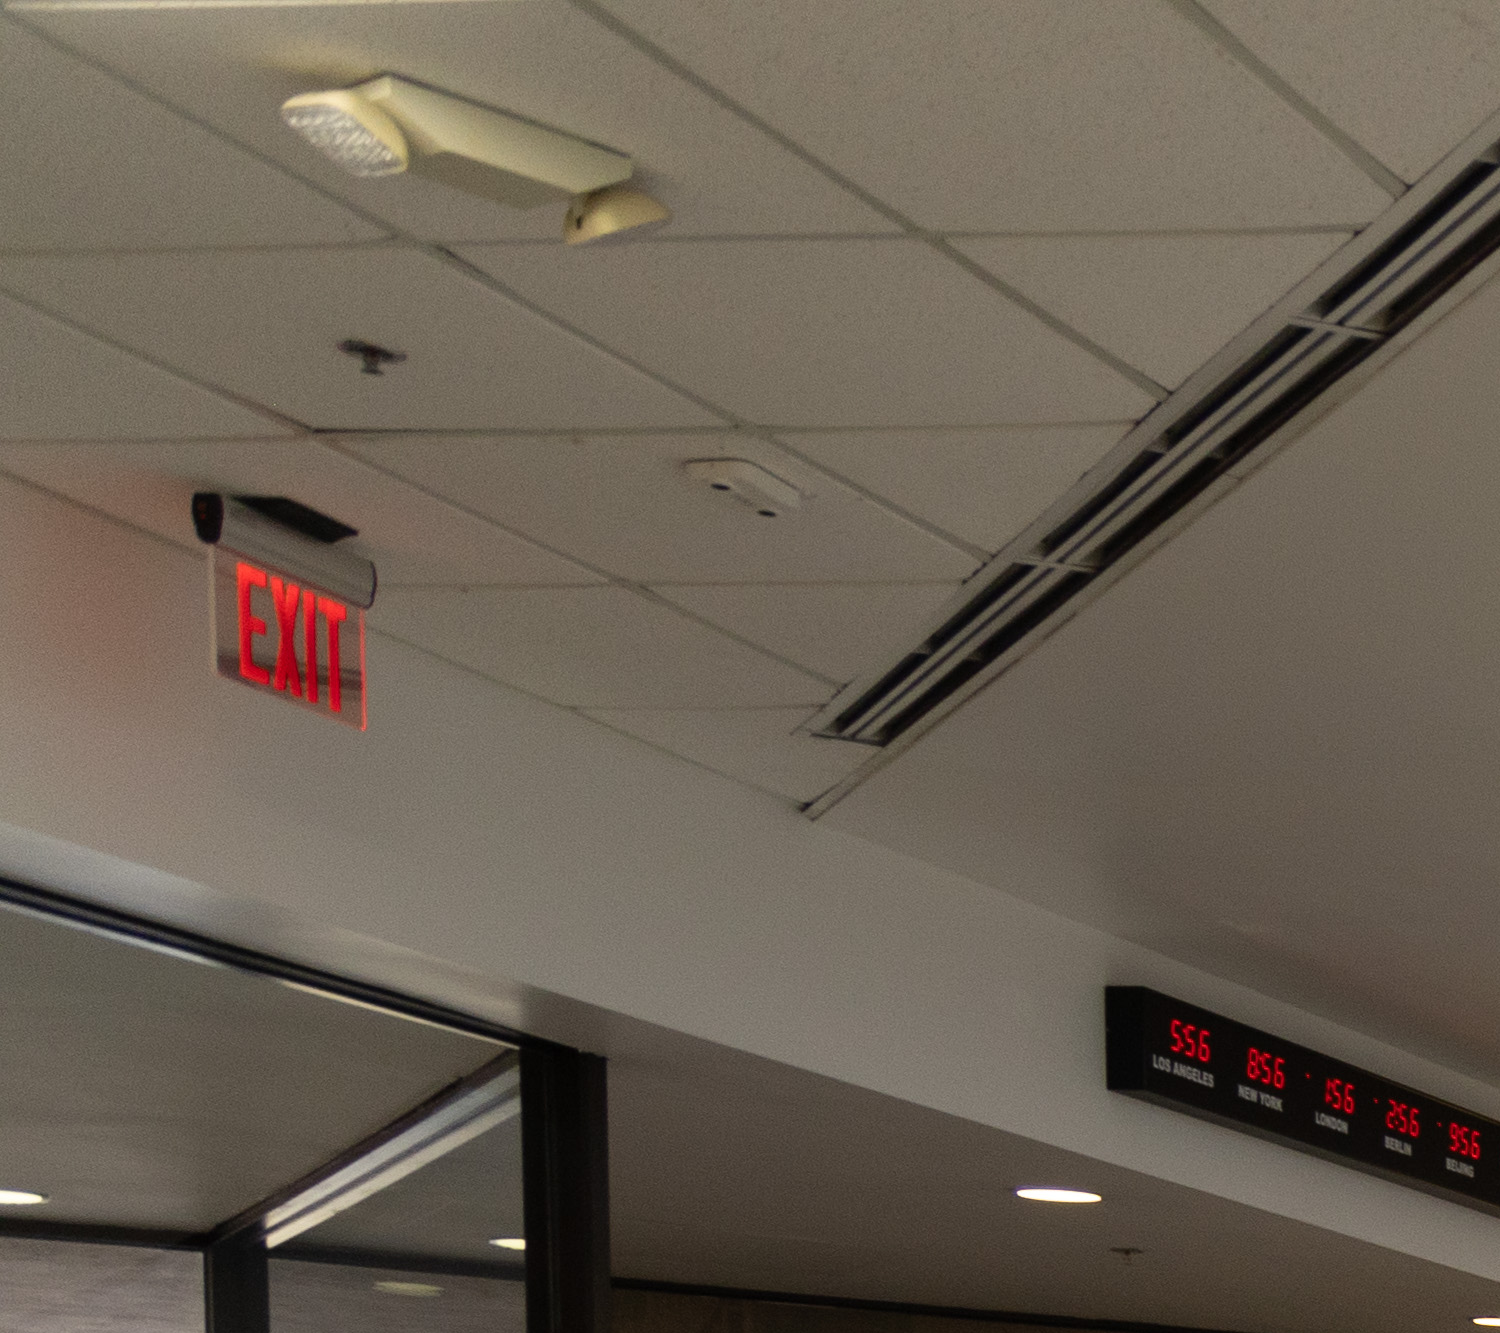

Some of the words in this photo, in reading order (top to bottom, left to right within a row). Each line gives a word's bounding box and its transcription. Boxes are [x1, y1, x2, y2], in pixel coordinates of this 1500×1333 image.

[236, 561, 347, 713] EXIT
[1153, 1054, 1171, 1073] LOS
[1172, 1060, 1215, 1089] ANGELES
[1238, 1083, 1258, 1103] NEW
[1259, 1091, 1283, 1113] YORK
[1315, 1111, 1349, 1135] LONDON
[1384, 1135, 1413, 1157] BERLIN
[1446, 1157, 1475, 1179] BEIJING
